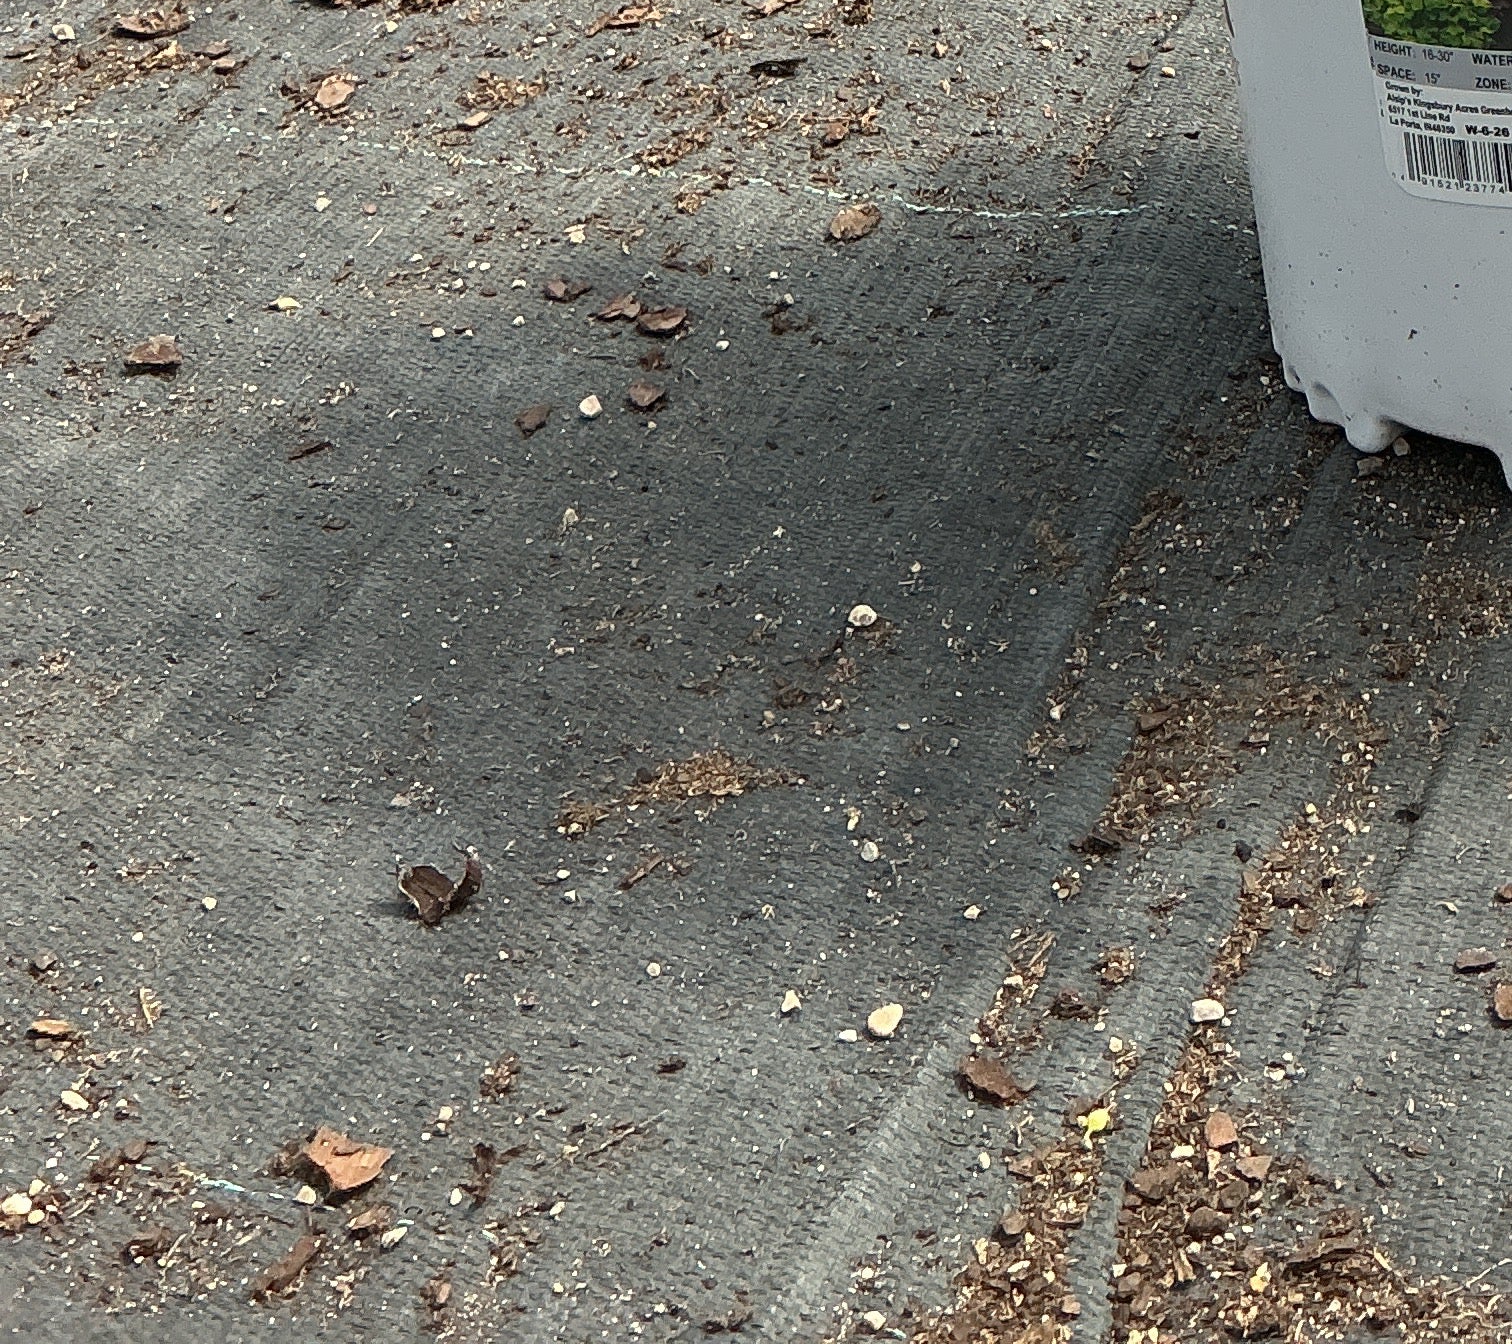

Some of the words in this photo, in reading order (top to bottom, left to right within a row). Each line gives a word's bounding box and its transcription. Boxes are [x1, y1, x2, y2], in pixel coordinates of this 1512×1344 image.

[1373, 39, 1417, 59] HEIGHT:
[1376, 63, 1417, 83] SPACE:
[1474, 77, 1512, 91] ZONE:
[1465, 124, 1511, 139] W-6-26
